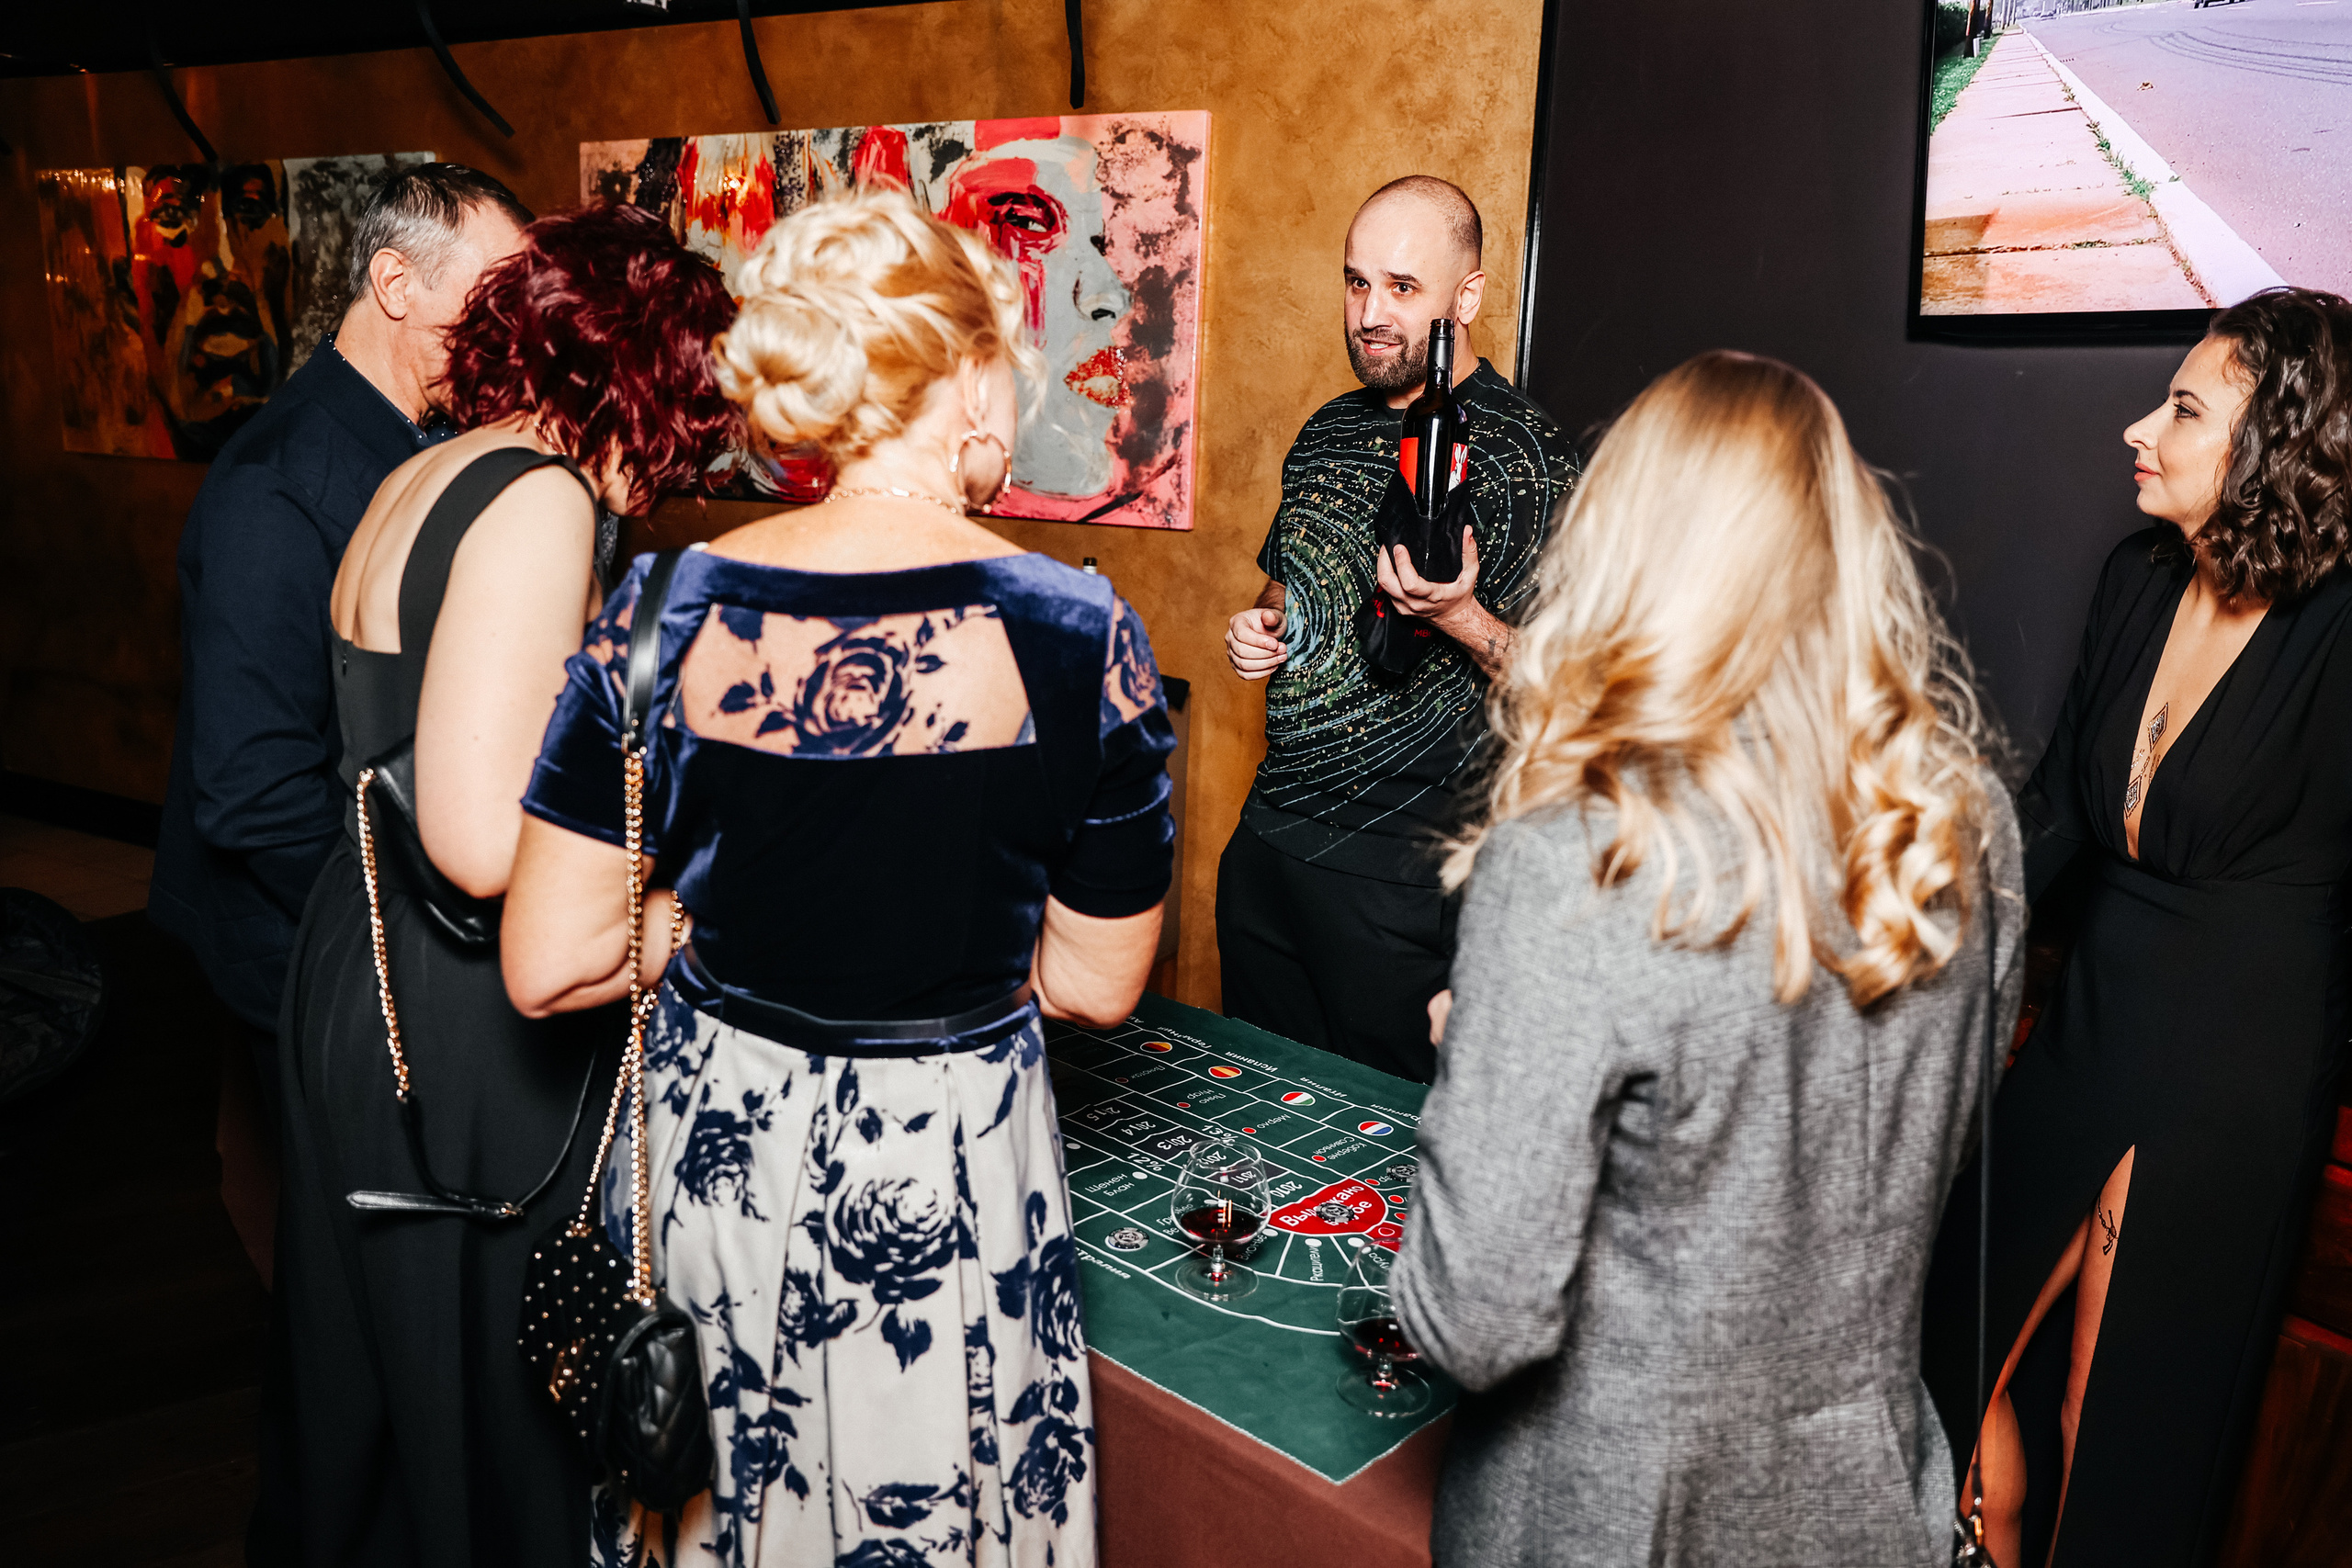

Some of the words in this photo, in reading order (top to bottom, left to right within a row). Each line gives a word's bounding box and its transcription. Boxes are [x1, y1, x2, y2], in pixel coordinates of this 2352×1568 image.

[1225, 1051, 1278, 1073] Испания
[1187, 1089, 1215, 1100] Нуар
[1300, 1077, 1348, 1098] Италия
[1199, 1092, 1227, 1105] Пино
[1257, 1114, 1292, 1129] Мерло
[1157, 1134, 1193, 1150] 2013
[1202, 1124, 1238, 1146] 13%
[1328, 1142, 1367, 1160] Каберне
[1126, 1152, 1166, 1171] 12%
[1231, 1171, 1256, 1184] 2011
[1103, 1181, 1136, 1197] Блан
[1270, 1180, 1303, 1198] 2010
